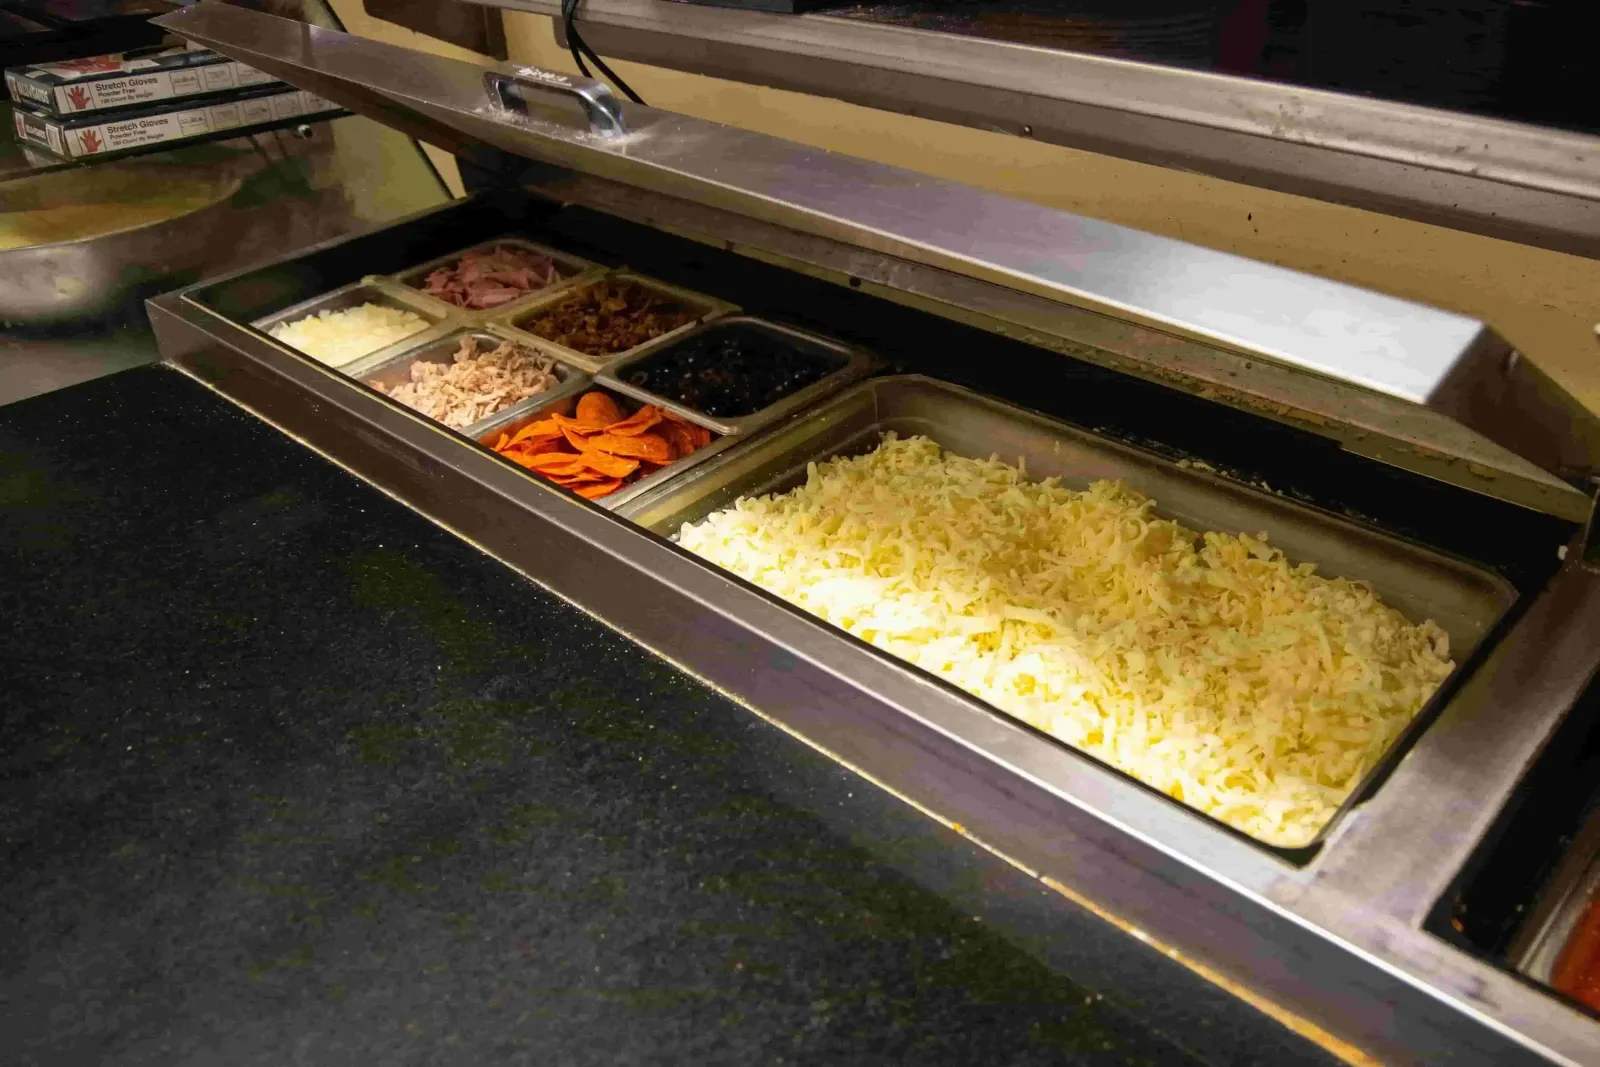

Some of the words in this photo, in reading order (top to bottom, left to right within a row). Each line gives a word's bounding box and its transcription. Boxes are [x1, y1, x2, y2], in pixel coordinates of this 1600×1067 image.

[95, 81, 127, 91] Stretch
[129, 77, 158, 86] Gloves
[107, 122, 138, 133] Stretch
[139, 119, 169, 128] Gloves
